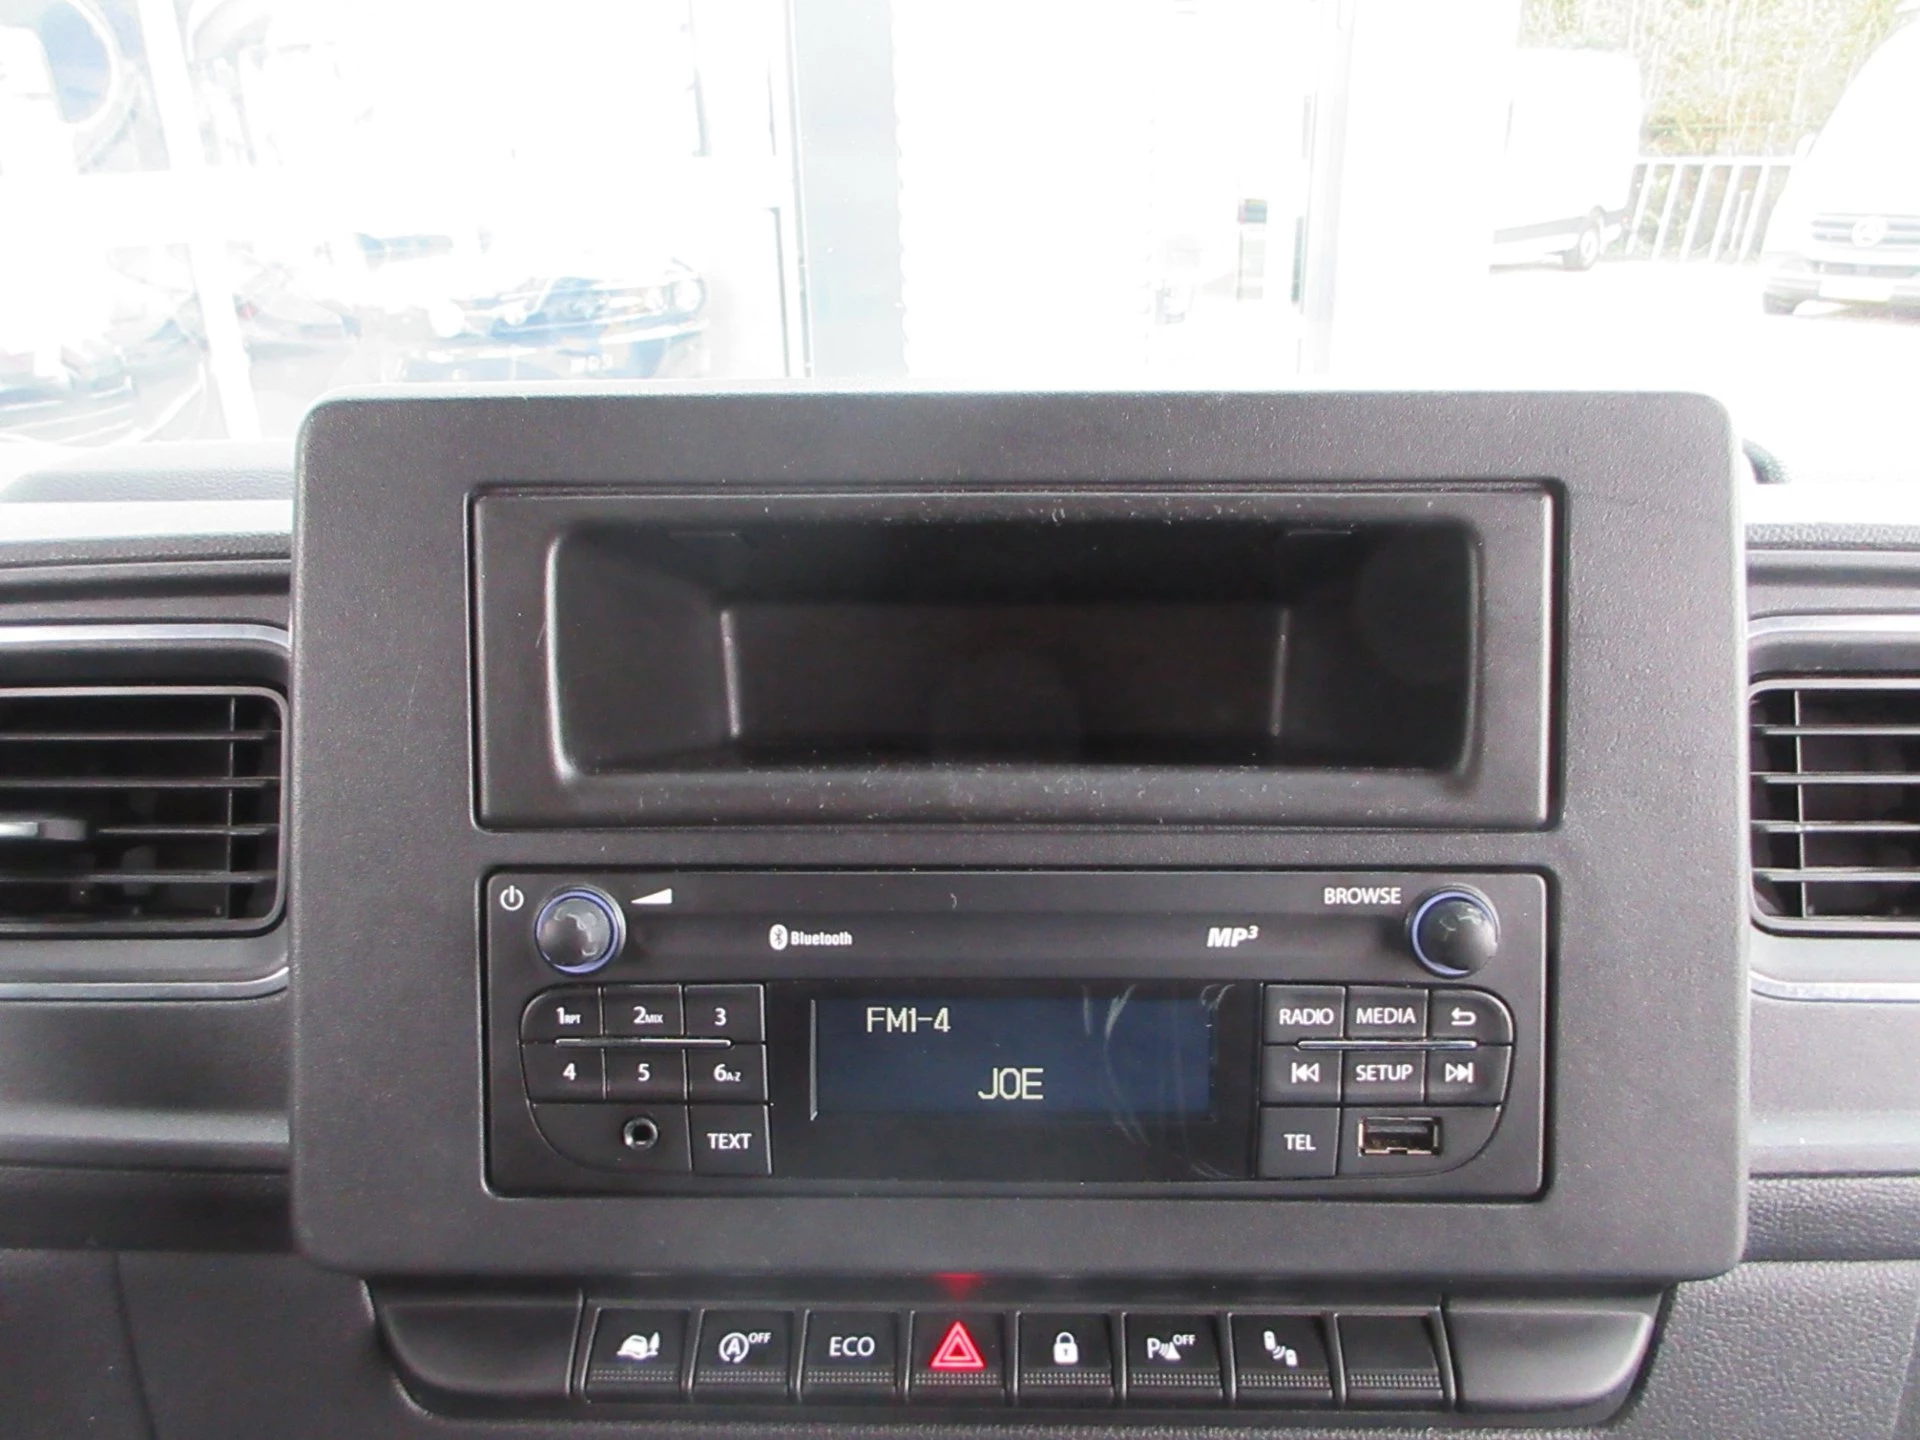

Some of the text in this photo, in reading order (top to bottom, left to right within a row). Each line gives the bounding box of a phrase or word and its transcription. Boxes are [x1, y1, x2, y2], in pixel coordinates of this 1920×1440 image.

[1324, 887, 1402, 905] BROWSE
[790, 930, 853, 946] Bluetooth
[1207, 925, 1259, 948] MP3
[714, 1008, 727, 1026] 3
[866, 1007, 951, 1033] FM1-4
[1279, 1008, 1335, 1025] RADIO
[1356, 1007, 1416, 1024] MEDIA
[563, 1063, 577, 1080] 4
[638, 1063, 650, 1081] 5
[1356, 1064, 1414, 1081] SETUP
[978, 1067, 1044, 1101] JOE
[707, 1132, 752, 1149] TEXT
[1284, 1134, 1316, 1151] TEL
[748, 1332, 772, 1344] OFF
[829, 1336, 875, 1357] ECO
[1172, 1334, 1196, 1346] OFF
